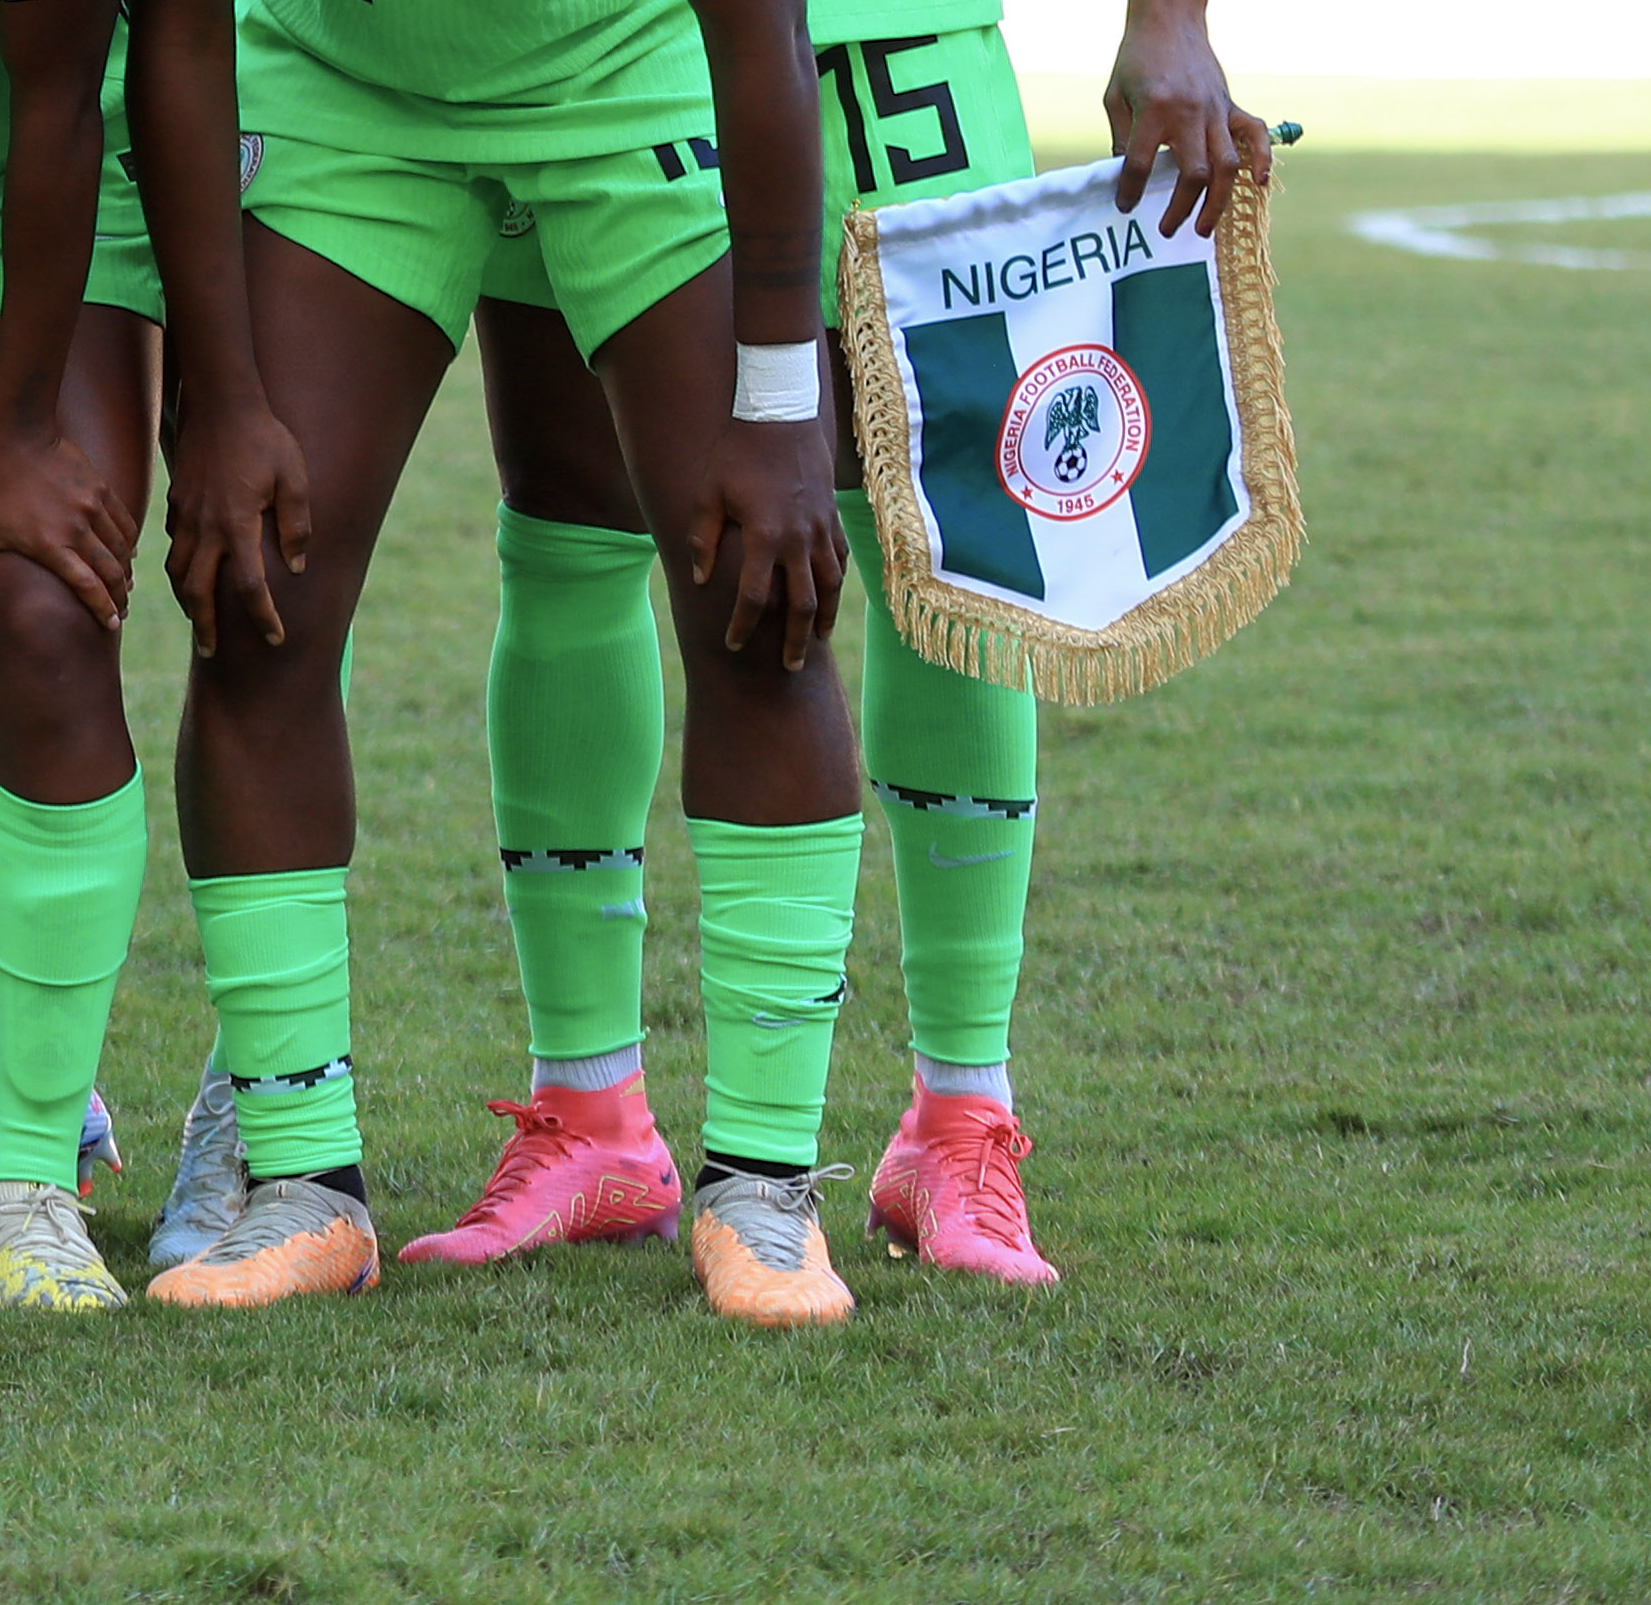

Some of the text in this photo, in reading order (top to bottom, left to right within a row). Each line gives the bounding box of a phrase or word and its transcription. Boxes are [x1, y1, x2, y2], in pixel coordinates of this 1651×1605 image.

[815, 34, 971, 194] 15
[941, 219, 1154, 310] NIGERIA
[1003, 353, 1142, 478] NIGERIA FOOTBALL FEDERATION
[1057, 493, 1095, 514] 1945
